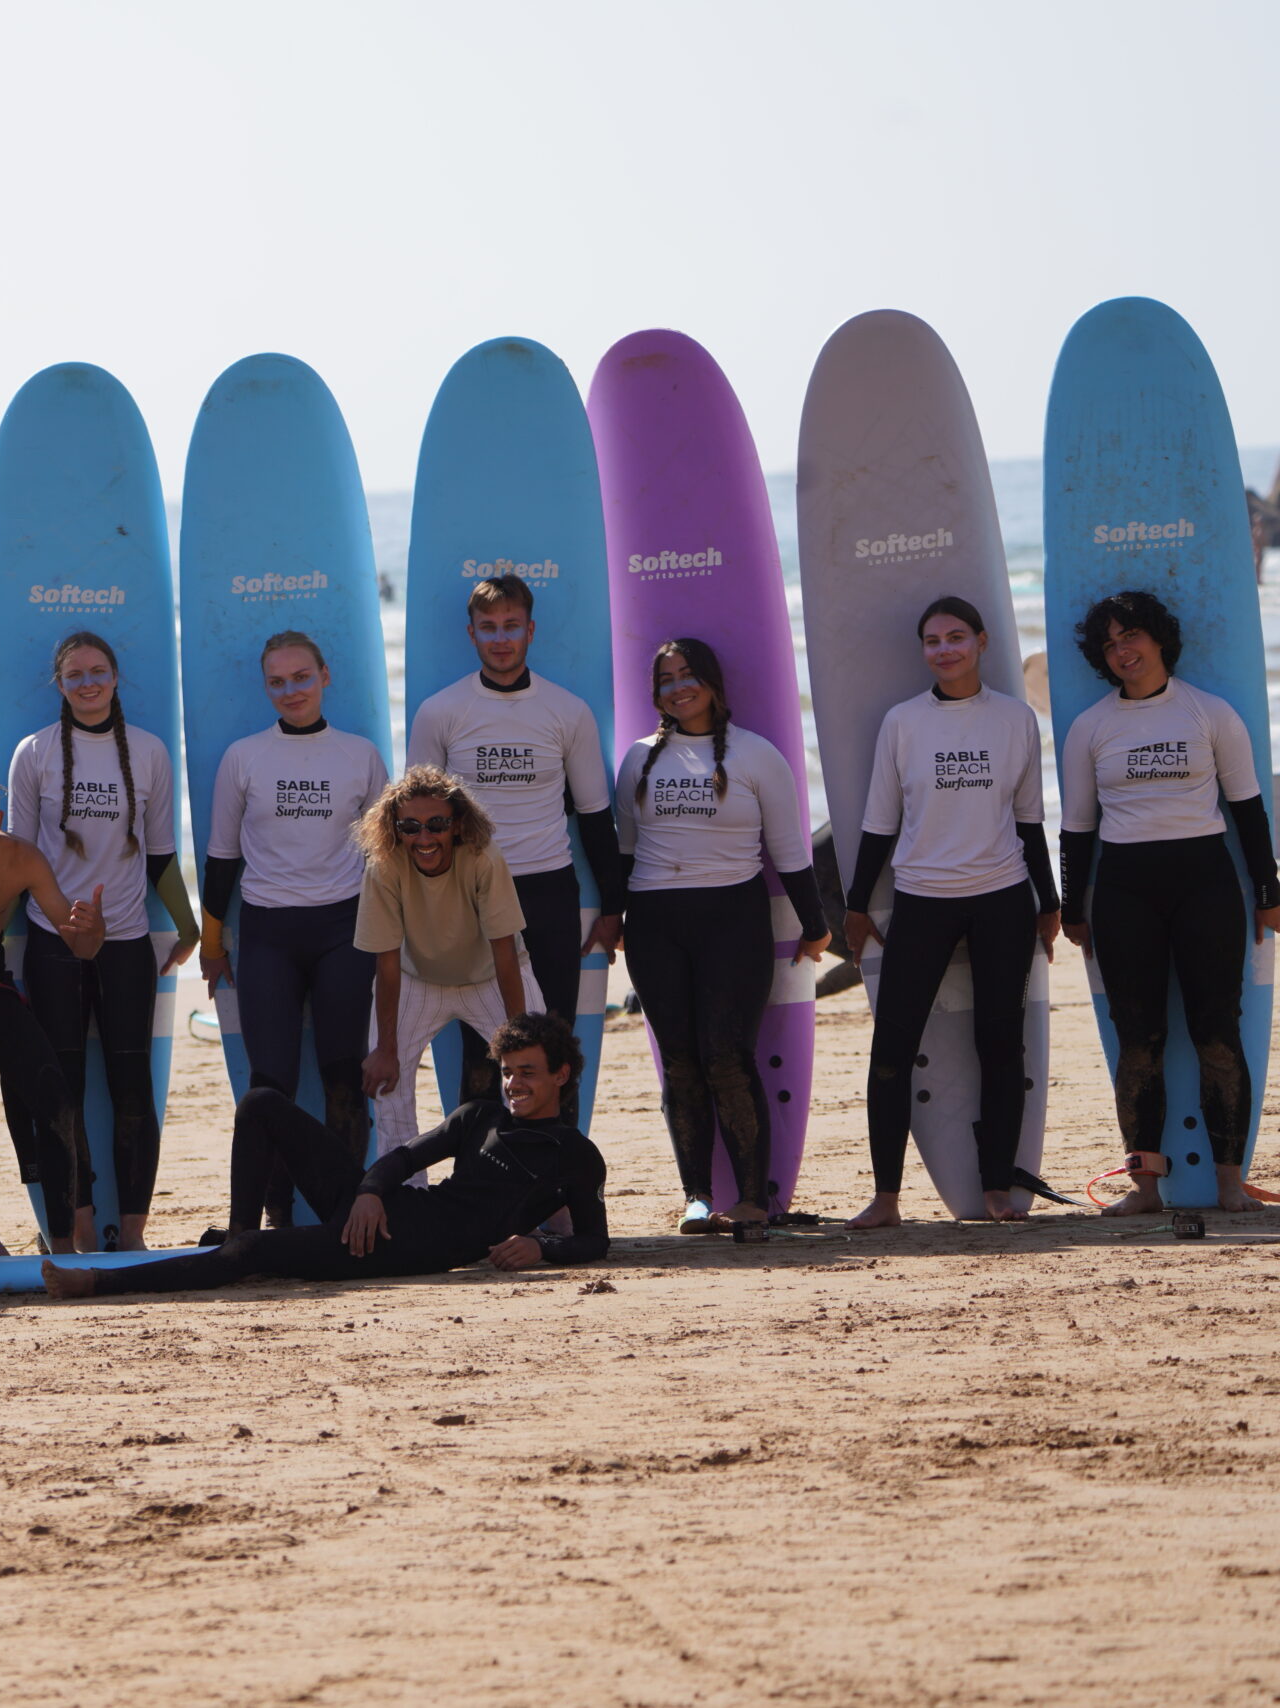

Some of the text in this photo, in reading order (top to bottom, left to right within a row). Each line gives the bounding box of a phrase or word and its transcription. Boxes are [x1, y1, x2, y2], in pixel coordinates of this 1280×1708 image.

[1093, 518, 1195, 544] Softech
[855, 527, 954, 559] Softech
[627, 547, 723, 573] Softech
[461, 558, 559, 579] Softech
[641, 569, 713, 581] softboards
[231, 570, 328, 594] Softech
[29, 584, 125, 605] Softech
[476, 746, 534, 758] SABLE
[935, 750, 990, 763] SABLE
[476, 758, 534, 770] BEACH
[1128, 754, 1188, 766] BEACH
[935, 762, 991, 776] BEACH
[1126, 767, 1190, 780] Surfcamp
[476, 772, 536, 785] Surfcamp
[655, 778, 714, 789] SABLE
[935, 776, 993, 791] Surfcamp
[71, 782, 118, 794] ABLE
[277, 780, 330, 792] SABLE
[276, 792, 330, 804] BEACH
[654, 790, 714, 802] BEACH
[69, 806, 120, 821] urfcamp
[275, 805, 333, 820] Surfcamp
[655, 803, 717, 818] Surfcamp
